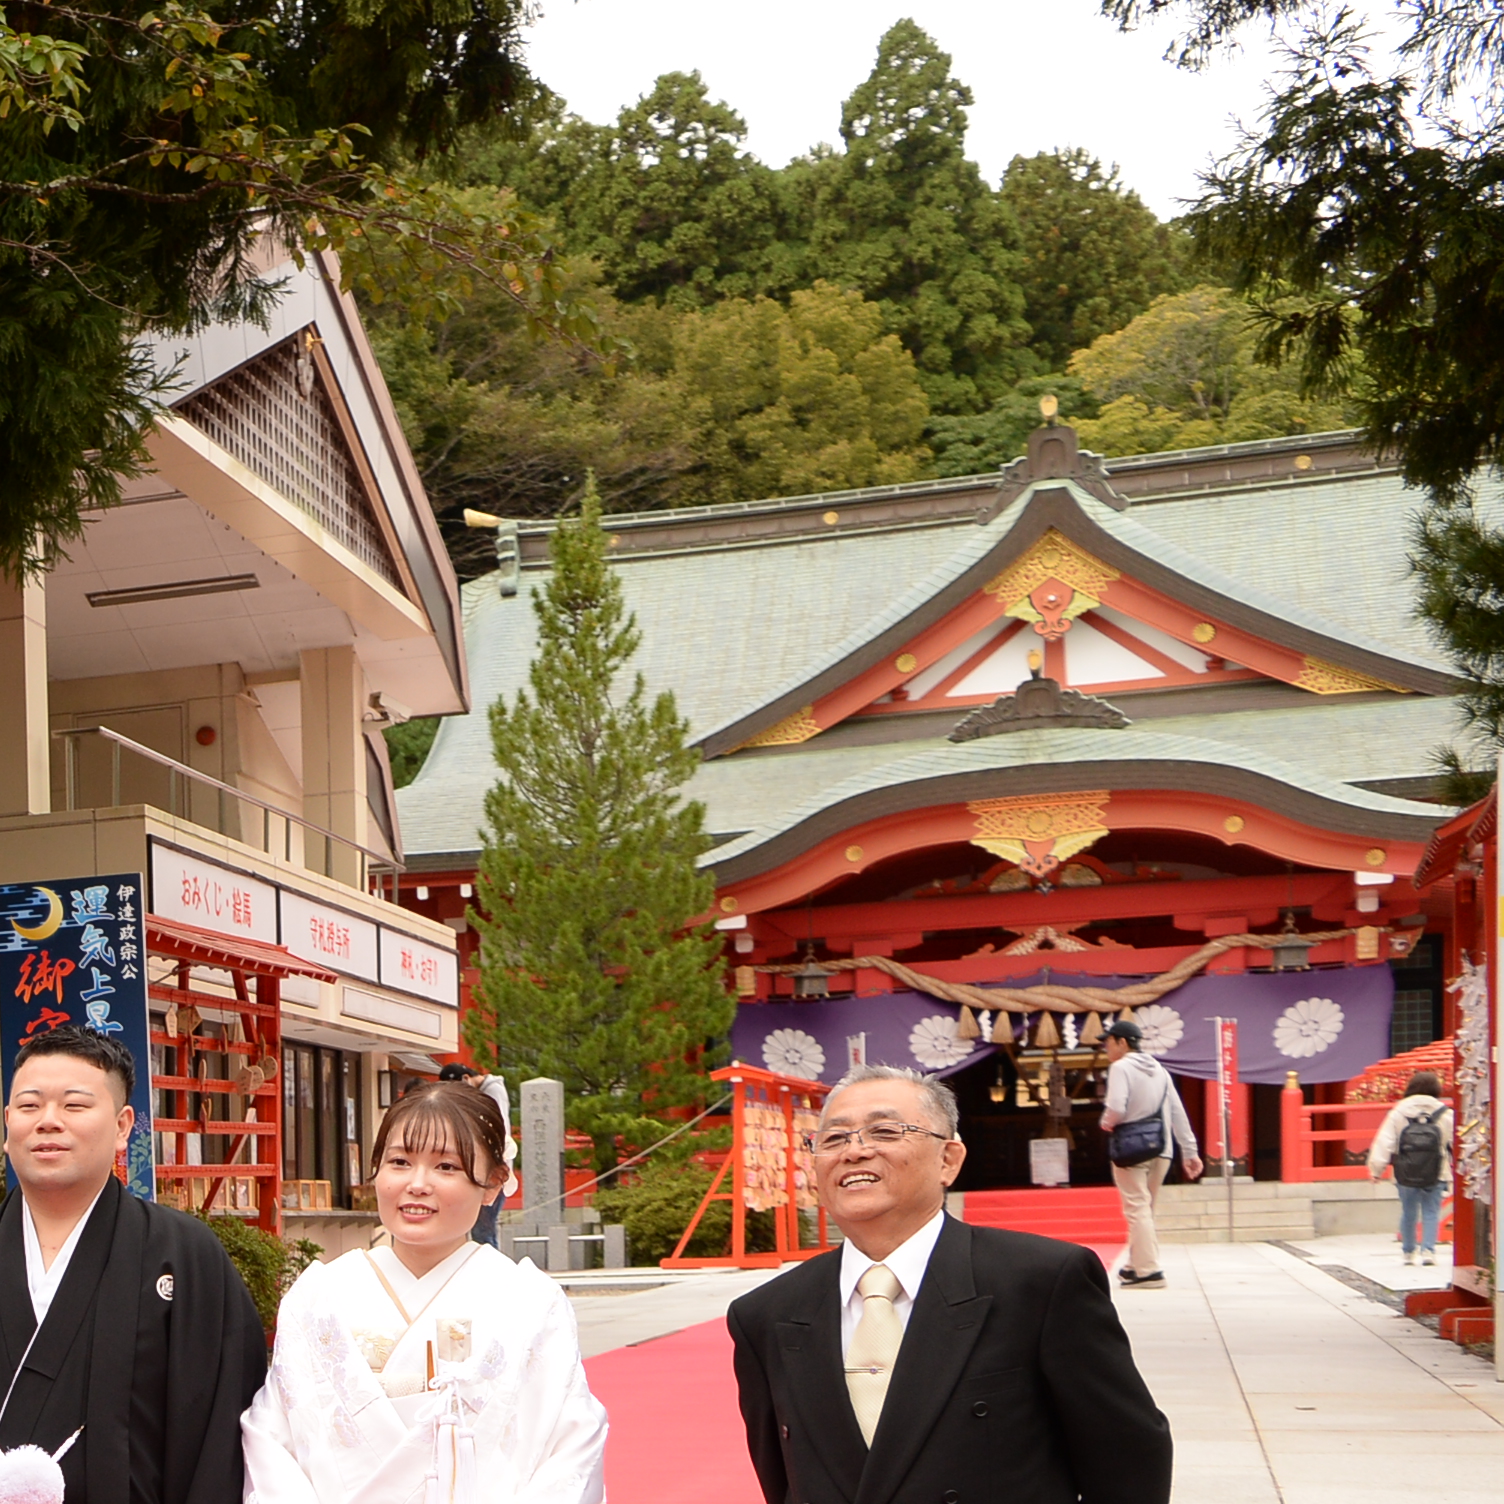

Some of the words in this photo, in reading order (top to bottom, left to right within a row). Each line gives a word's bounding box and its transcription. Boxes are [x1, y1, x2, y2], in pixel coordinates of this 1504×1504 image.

[116, 884, 139, 980] 伊達政宗公
[181, 870, 252, 928] おみくじ・絵馬
[309, 915, 351, 959] 守札授与所
[70, 885, 124, 1037] 運気上昇
